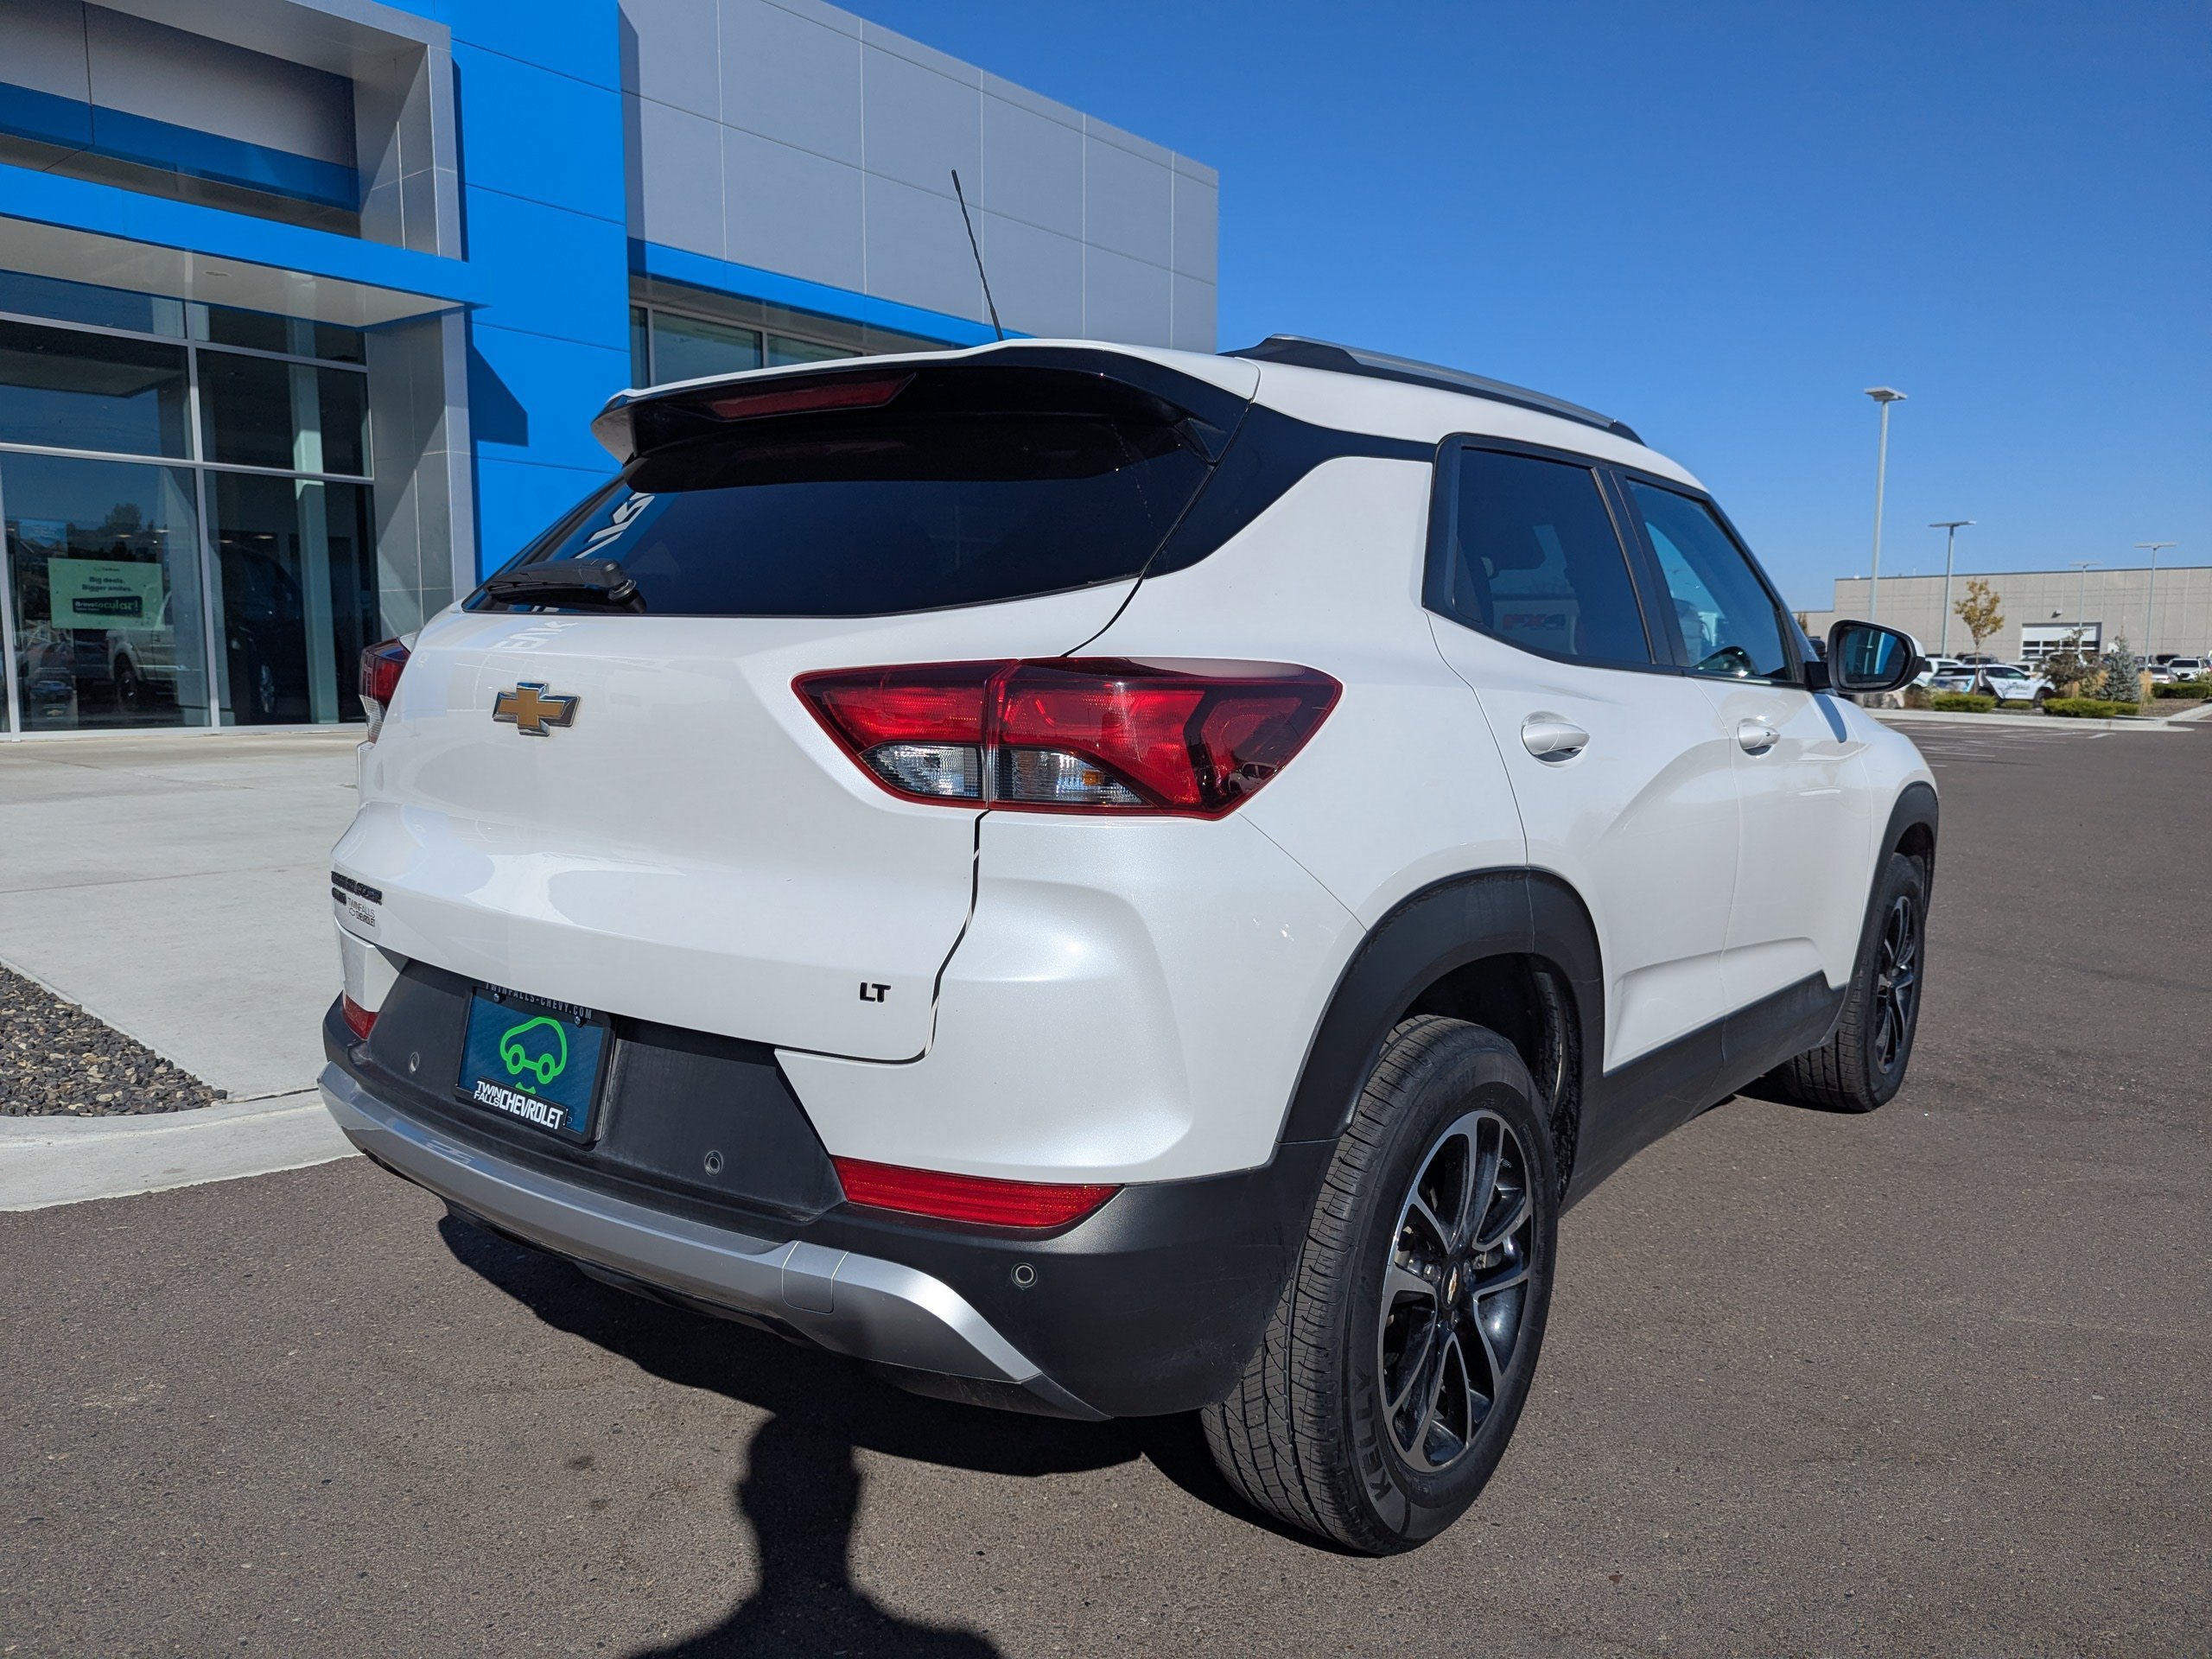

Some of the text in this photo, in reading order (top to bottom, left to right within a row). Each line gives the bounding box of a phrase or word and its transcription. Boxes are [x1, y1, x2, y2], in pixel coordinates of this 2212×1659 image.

[860, 982, 892, 1003] LT
[473, 1090, 500, 1107] FALLS
[476, 1080, 503, 1098] TWIN
[499, 1090, 564, 1130] CHEVROLET
[1353, 1365, 1393, 1502] KELLY
